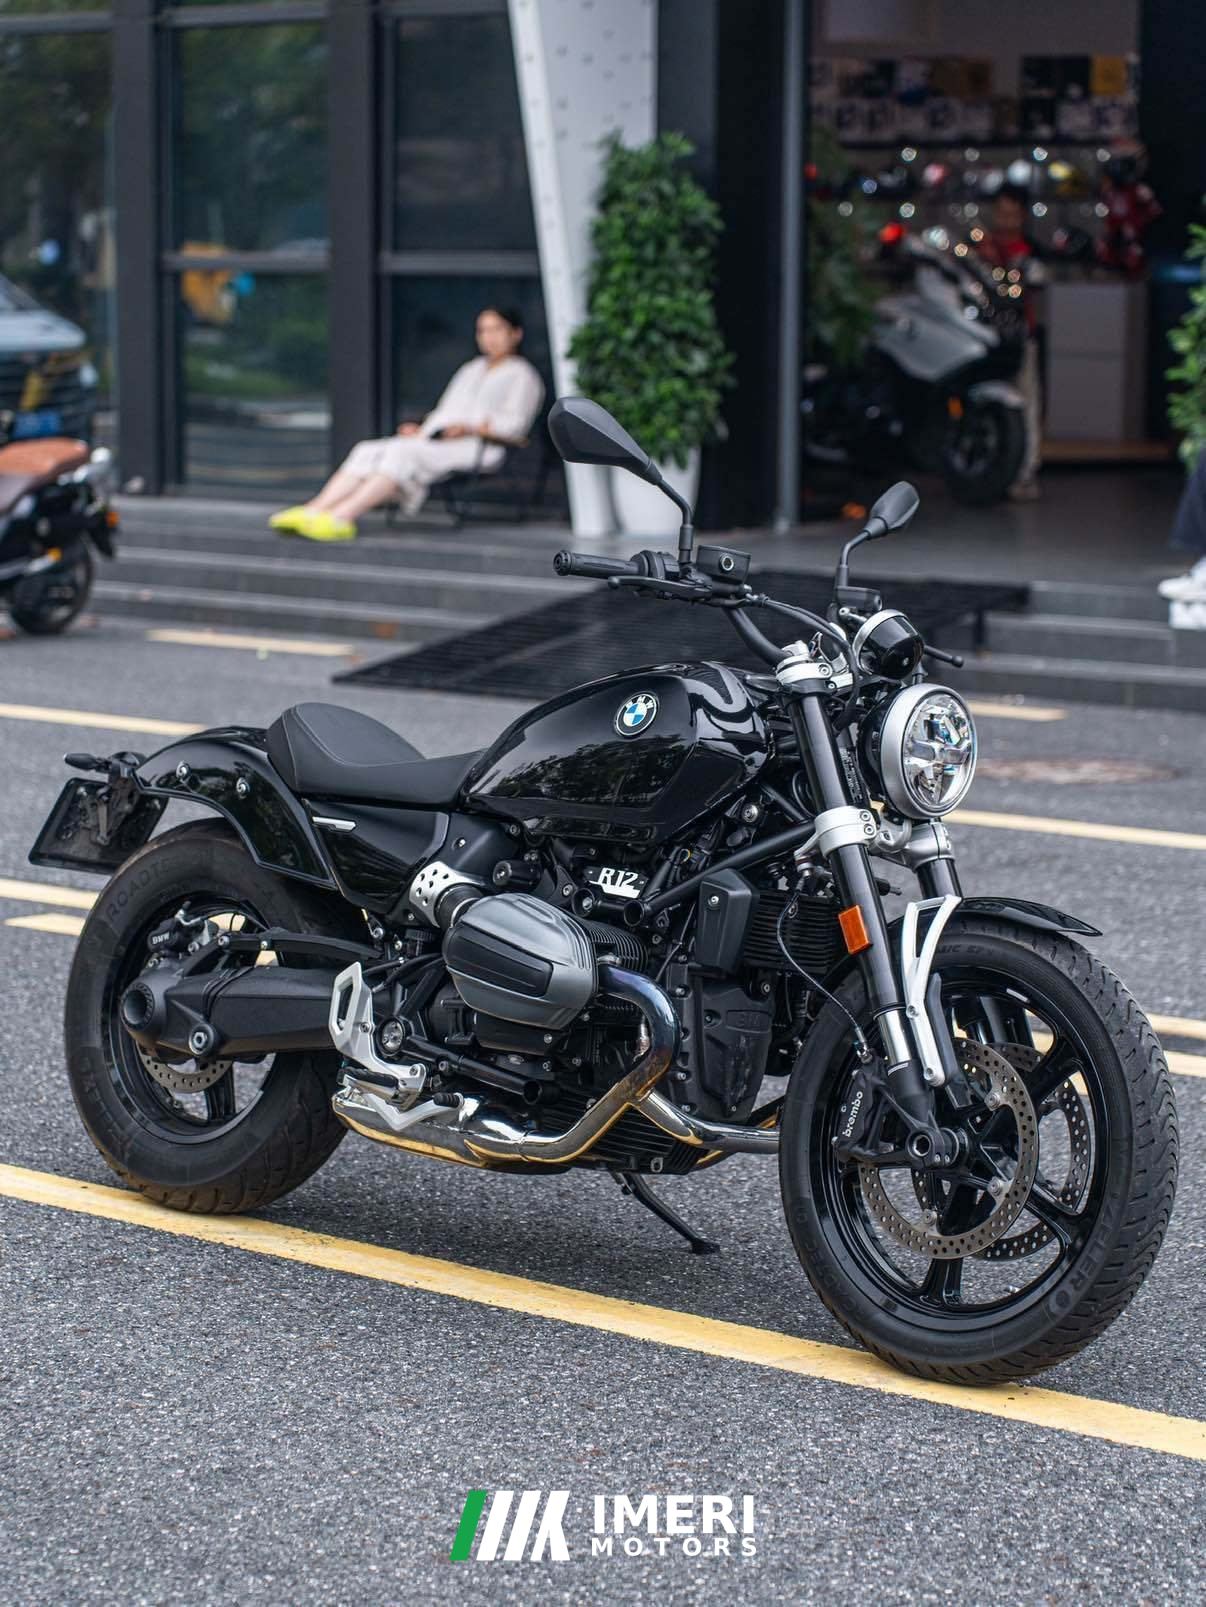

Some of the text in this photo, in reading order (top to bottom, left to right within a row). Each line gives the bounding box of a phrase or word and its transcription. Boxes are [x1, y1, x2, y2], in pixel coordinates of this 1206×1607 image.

[105, 858, 171, 921] ROADTE
[598, 867, 639, 888] R12
[841, 1091, 863, 1138] brembo
